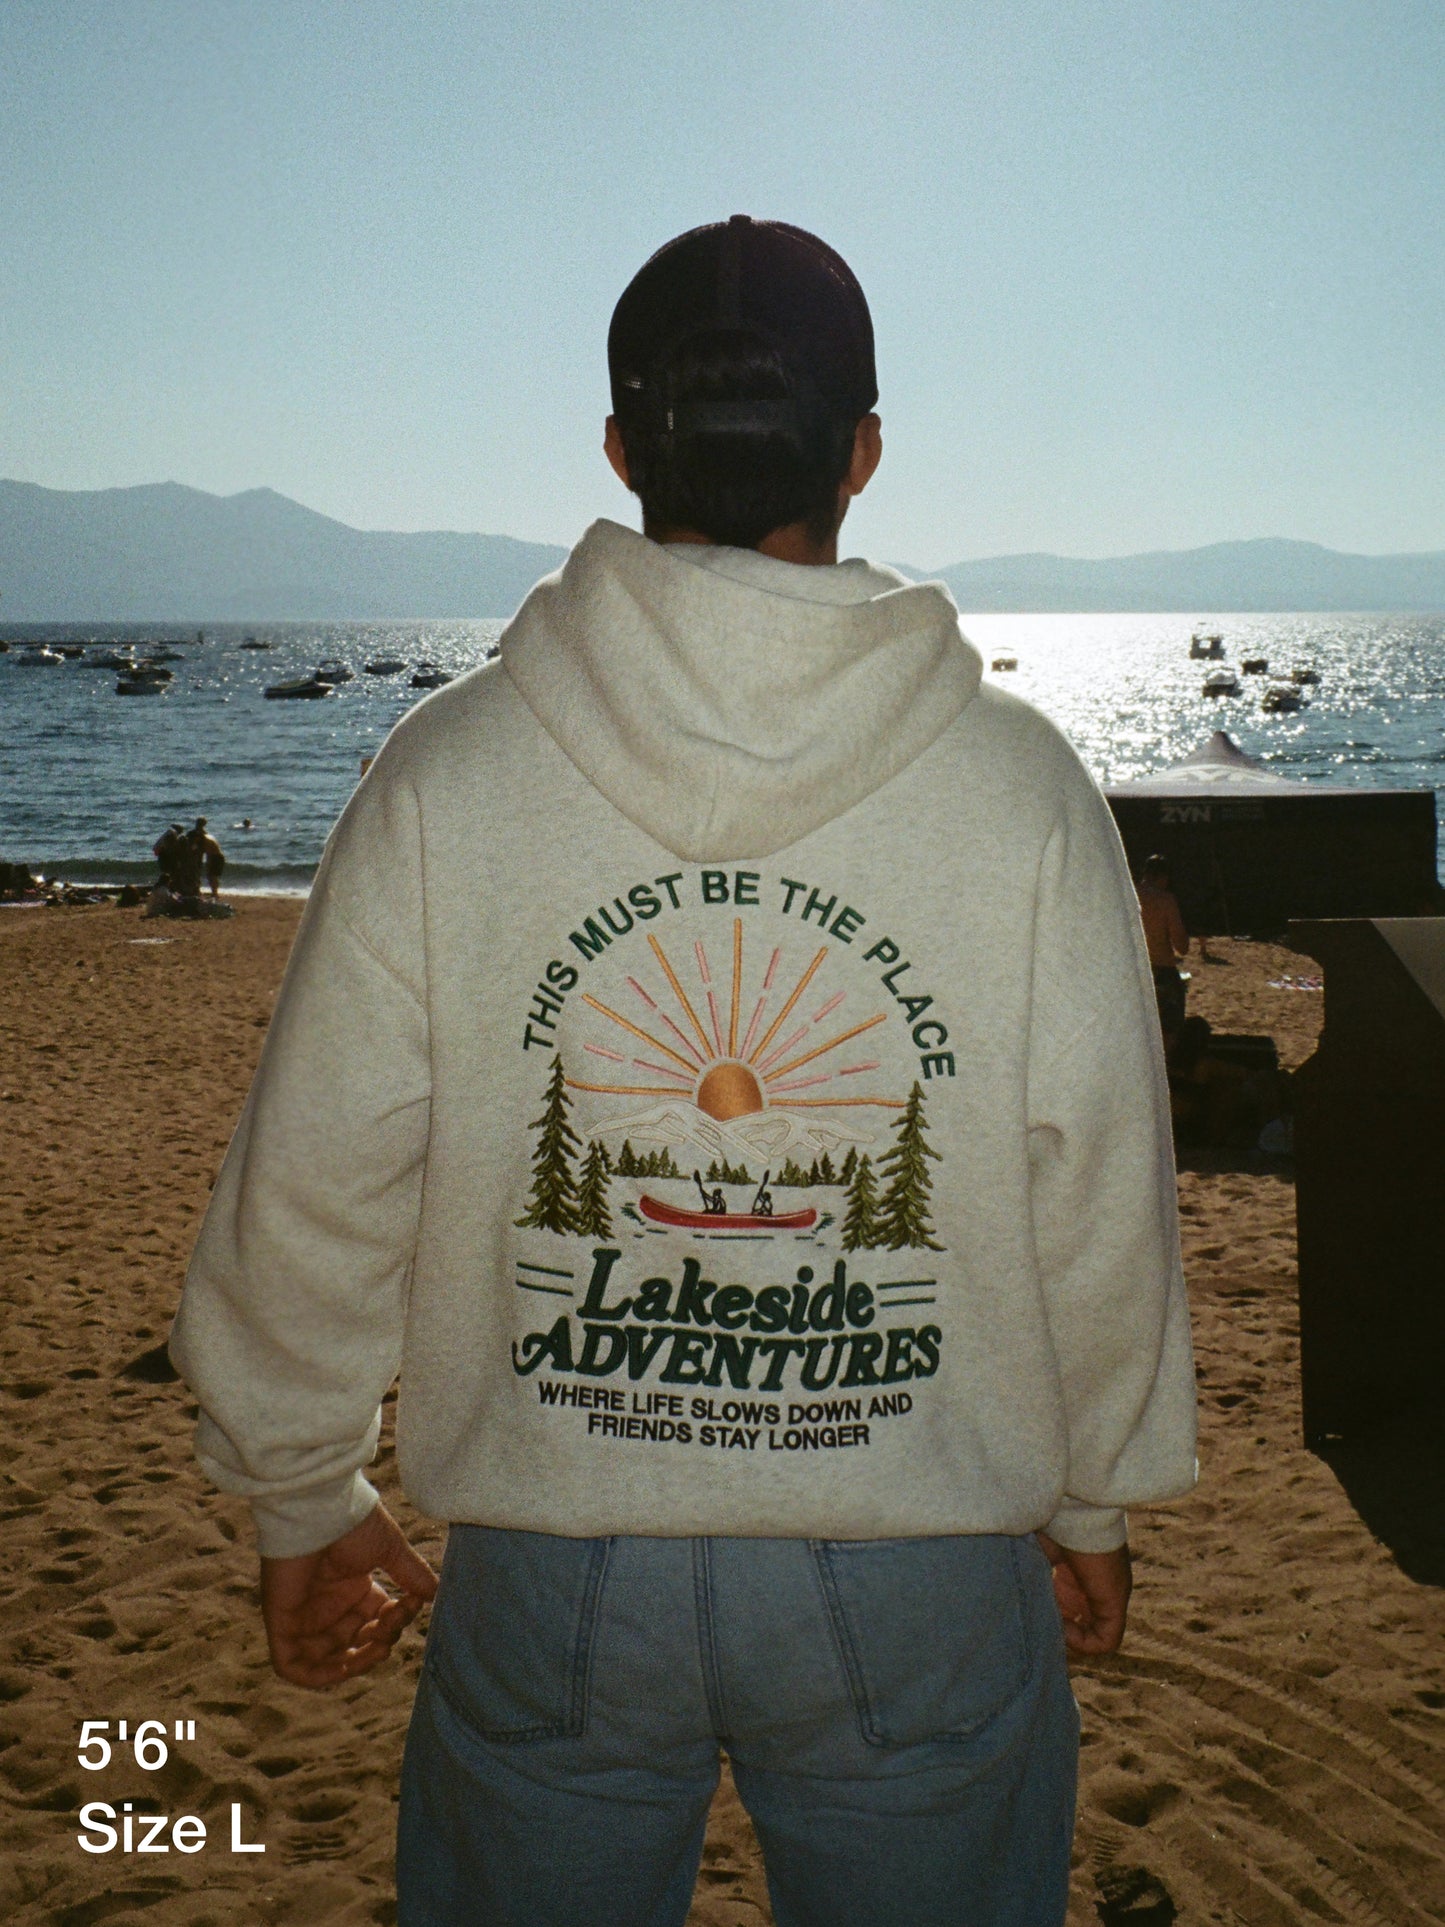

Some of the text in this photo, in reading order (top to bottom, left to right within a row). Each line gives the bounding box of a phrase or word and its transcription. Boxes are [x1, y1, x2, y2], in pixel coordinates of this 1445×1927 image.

[1160, 806, 1211, 823] ZYN
[523, 870, 956, 1080] THIS MUST BE THE PLACE
[576, 1248, 876, 1335] Lakeside
[512, 1315, 943, 1392] ADVENTURES
[539, 1381, 914, 1425] WHERE LIFE SLOWS DOWN AND
[587, 1412, 871, 1450] FRIENDS STAY LONGER
